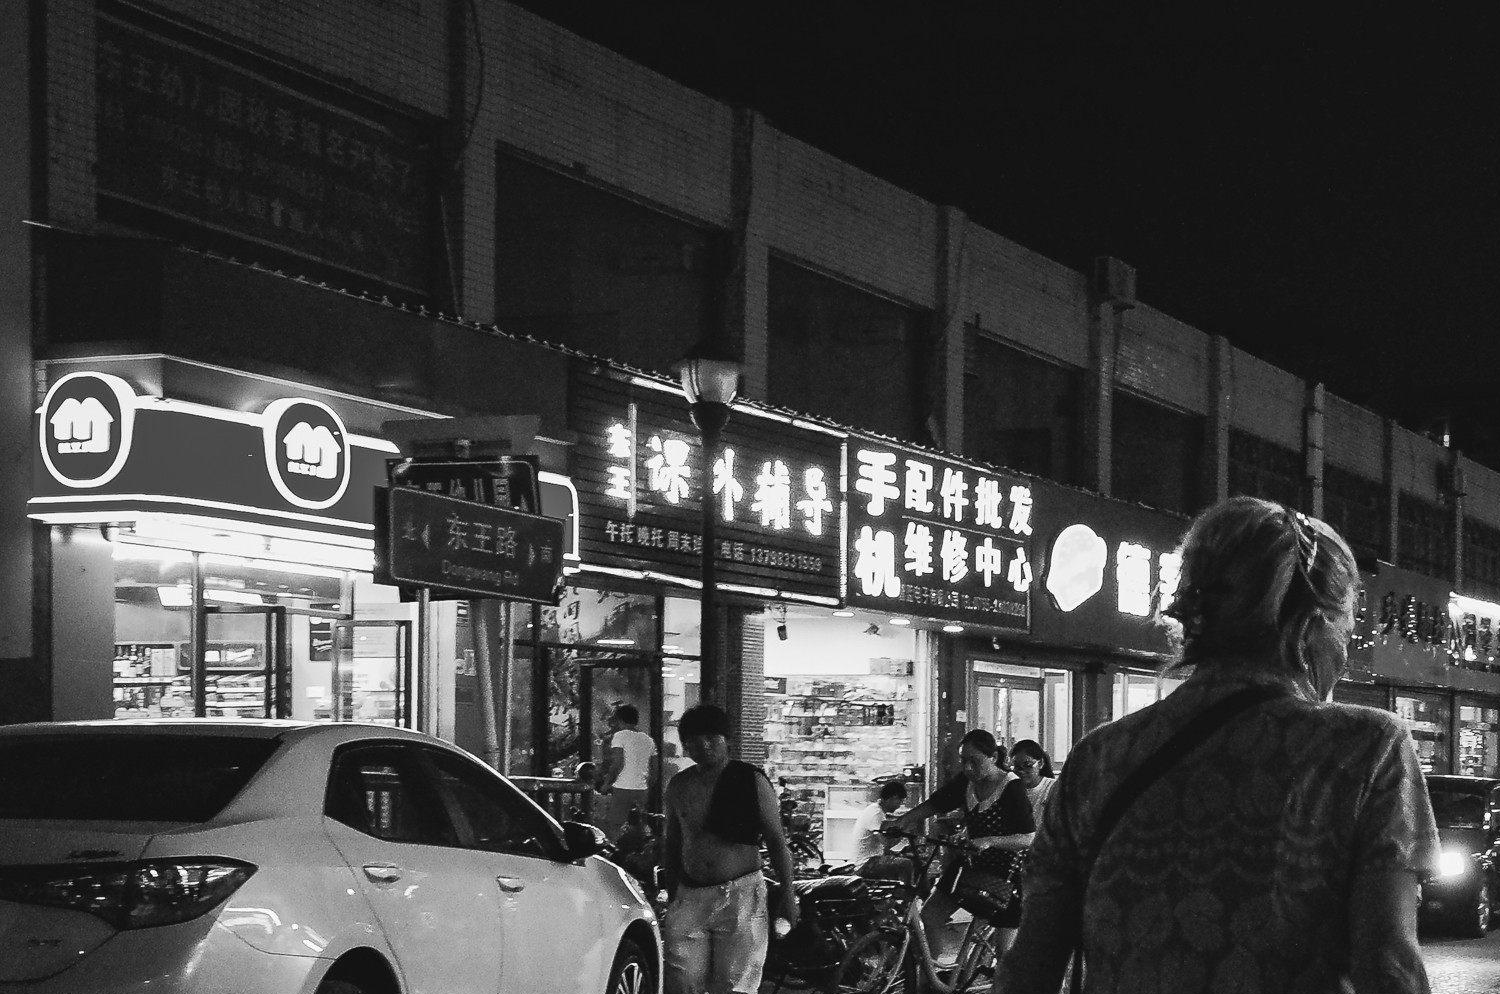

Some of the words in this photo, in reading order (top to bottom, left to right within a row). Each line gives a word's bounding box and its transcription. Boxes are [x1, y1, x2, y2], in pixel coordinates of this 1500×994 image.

[855, 449, 901, 598] 手机
[904, 459, 1034, 536] 配件批发
[446, 511, 519, 559] 东王路
[605, 520, 635, 544] 午托
[720, 541, 745, 561] 电话
[904, 522, 1034, 593] 维修中心
